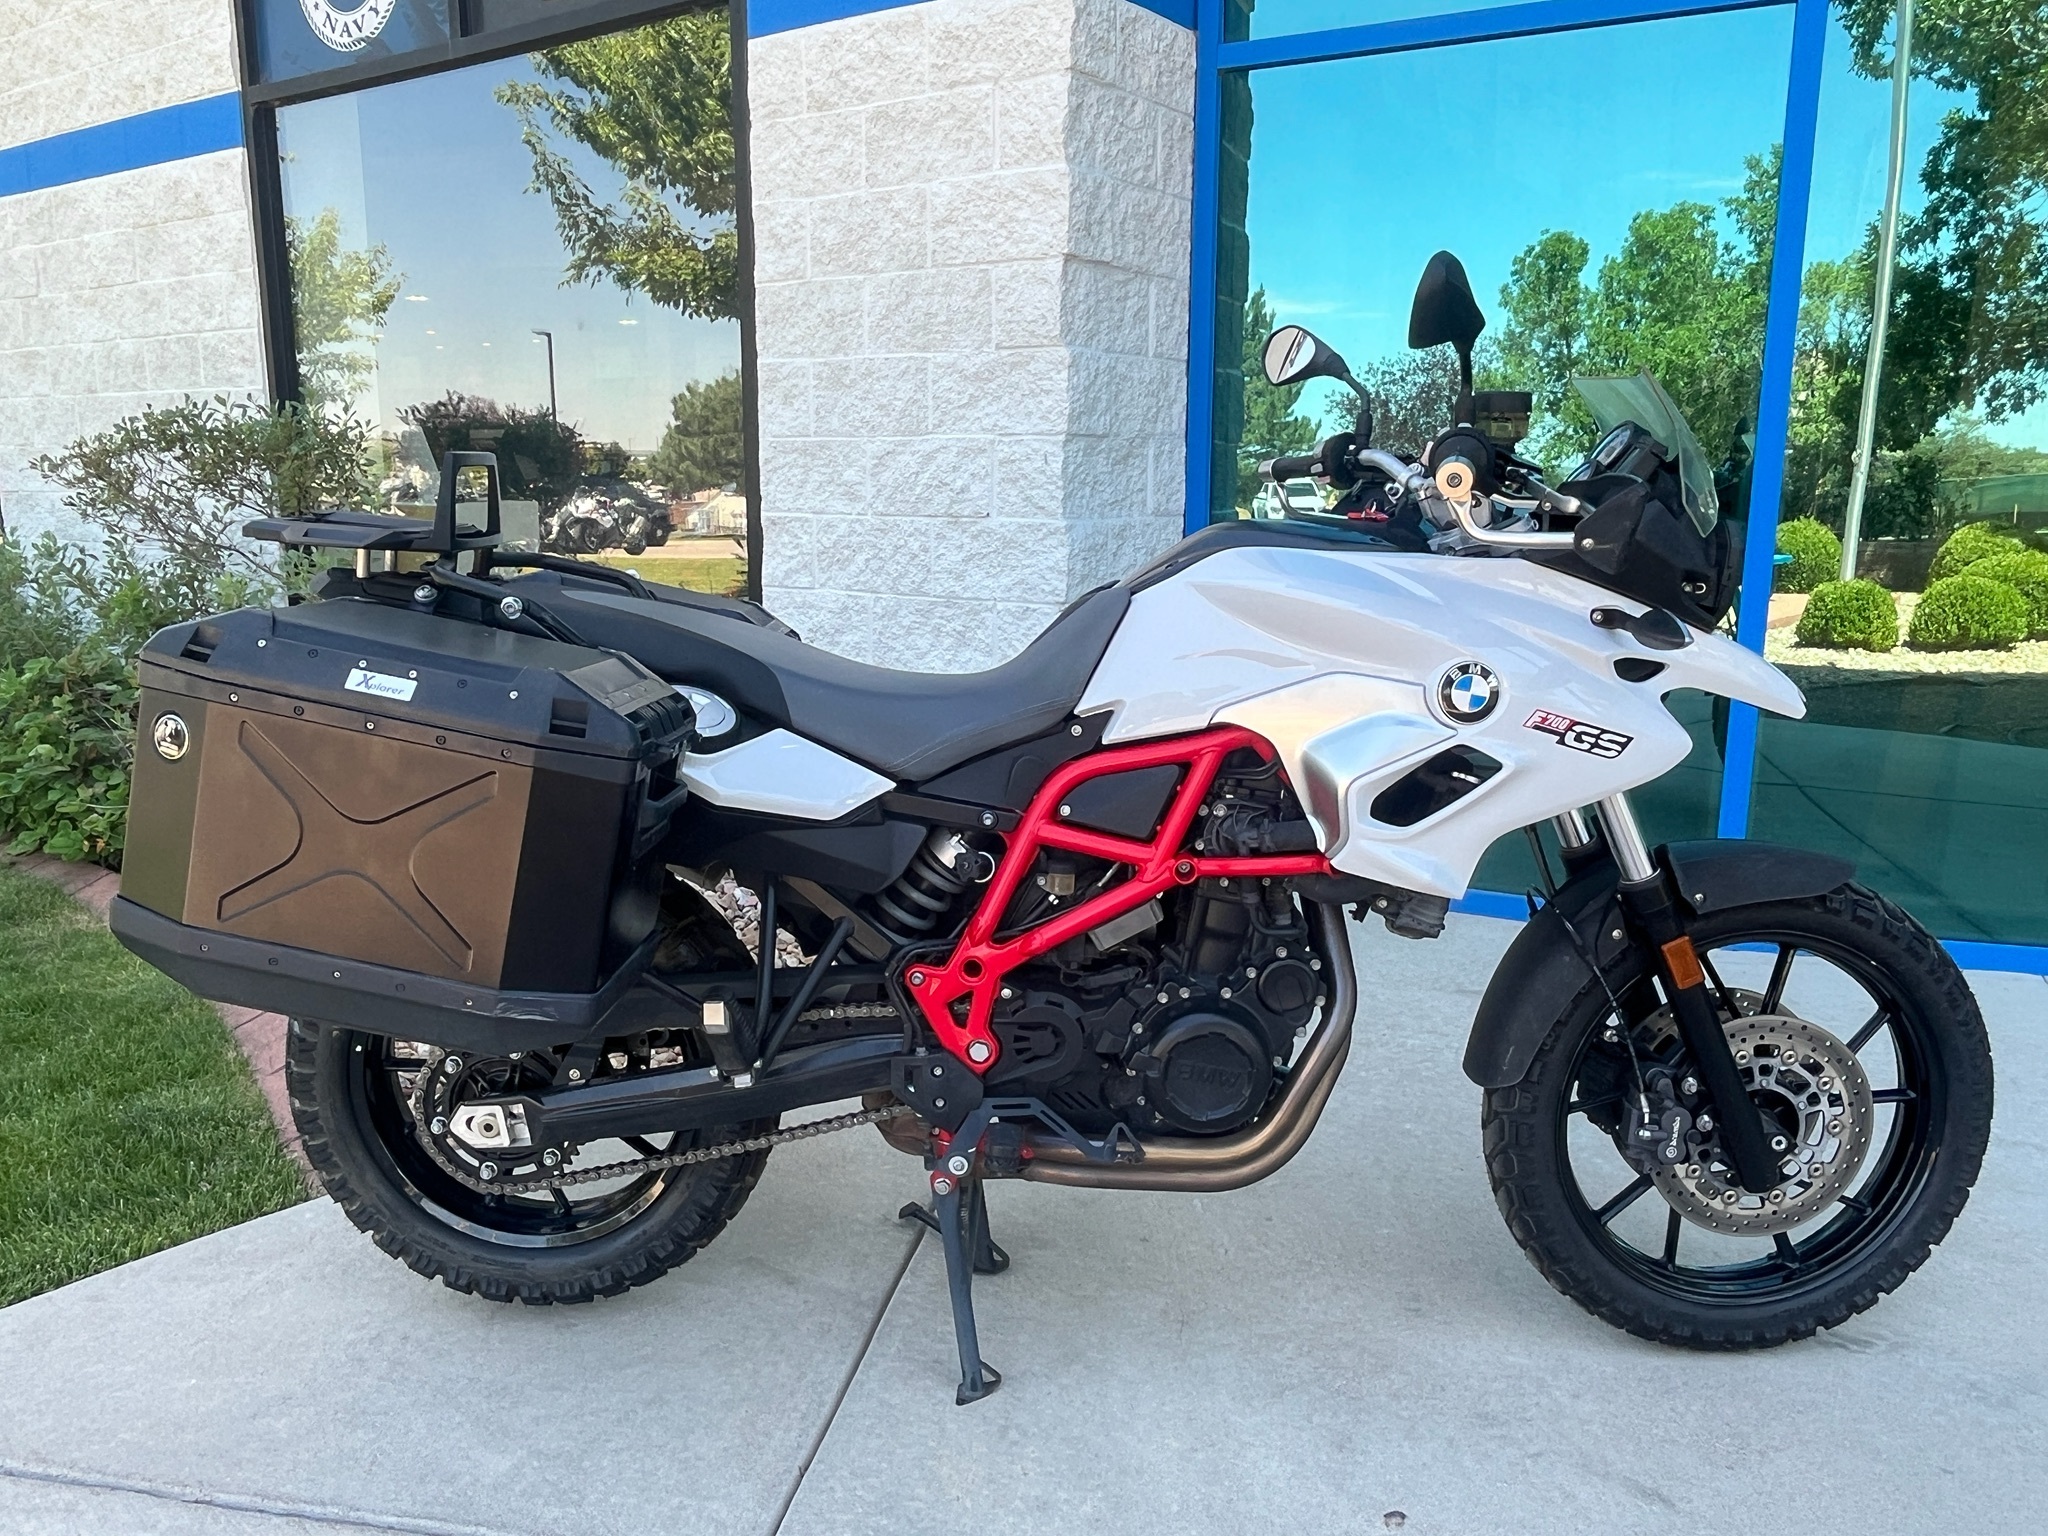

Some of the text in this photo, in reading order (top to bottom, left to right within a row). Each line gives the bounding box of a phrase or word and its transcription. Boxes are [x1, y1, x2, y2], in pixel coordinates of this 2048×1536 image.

[322, 0, 380, 38] NAVY
[1450, 663, 1498, 688] BMW
[1563, 724, 1629, 757] GS
